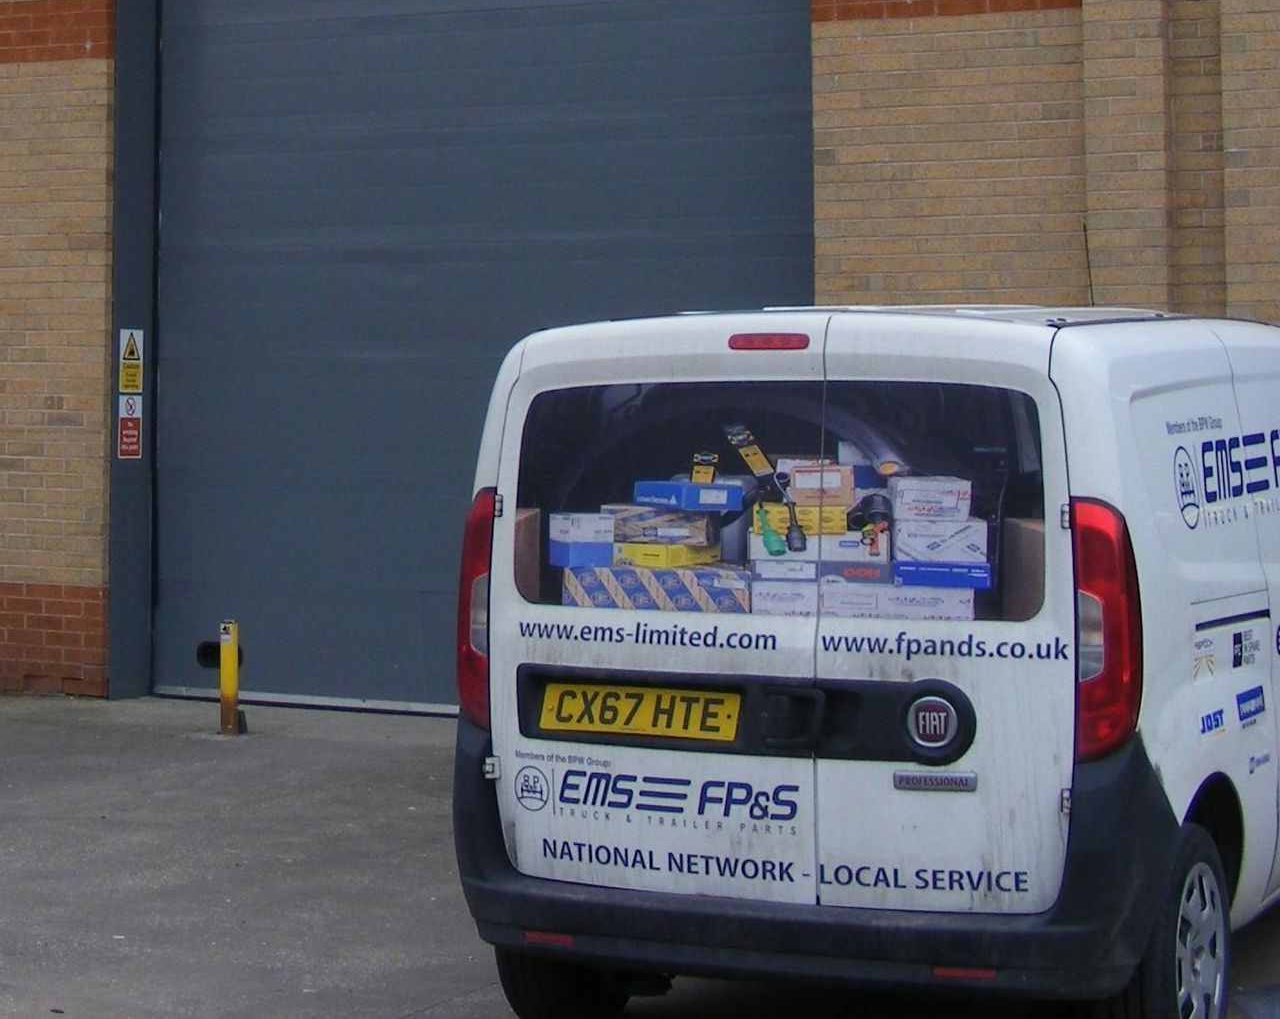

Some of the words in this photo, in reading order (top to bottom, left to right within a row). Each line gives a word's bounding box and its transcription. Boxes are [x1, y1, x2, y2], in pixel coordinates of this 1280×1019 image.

[1202, 437, 1243, 503] EMS
[519, 621, 777, 651] www.ems-limited.com
[821, 631, 1069, 661] www.fpands.co.uk
[555, 690, 645, 727] CX67
[651, 694, 725, 733] HTE
[918, 711, 948, 735] FIAT
[1200, 708, 1224, 734] JOST
[515, 749, 545, 761] Members
[555, 755, 567, 763] the
[567, 755, 585, 765] BPW
[559, 769, 638, 810] EMS
[697, 780, 800, 822] FP&S
[898, 774, 969, 788] PROFESSIONAL
[560, 807, 610, 822] TRUCK
[626, 814, 632, 824] &
[647, 815, 724, 831] TRAILER
[739, 822, 798, 836] PARTS
[542, 838, 661, 872] NATIONAL
[668, 851, 795, 883] NETWORK
[819, 863, 907, 889] LOCAL
[914, 868, 1029, 893] SERVICE
